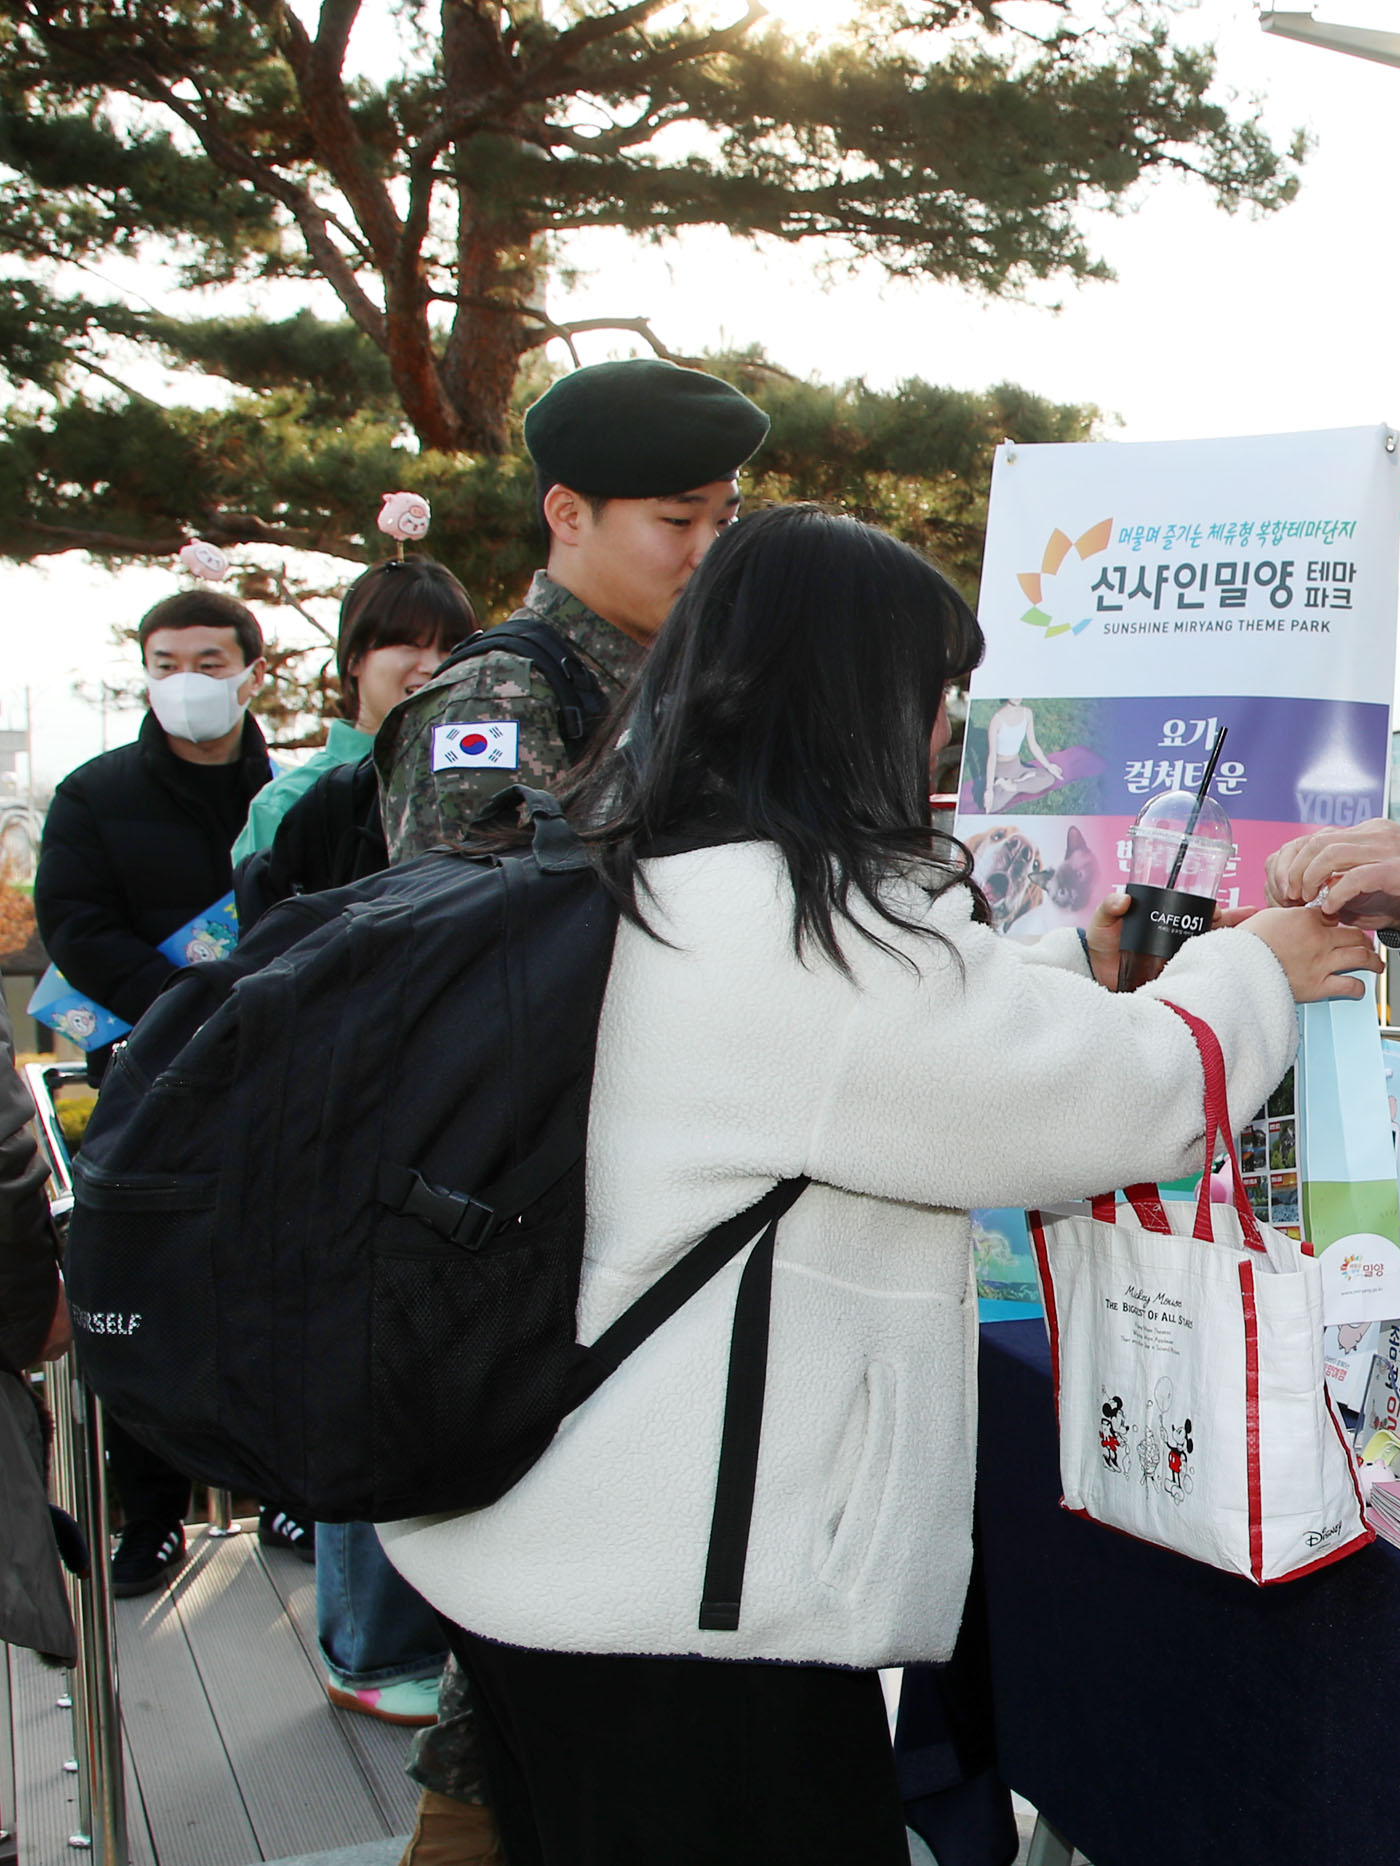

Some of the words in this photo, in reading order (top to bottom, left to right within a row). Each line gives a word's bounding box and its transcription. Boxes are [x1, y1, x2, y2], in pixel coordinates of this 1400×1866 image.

[1118, 525, 1162, 552] 머물며
[1162, 523, 1204, 551] 즐기는
[1207, 520, 1255, 548] 체류형
[1256, 519, 1358, 548] 복합테마단지
[1090, 559, 1295, 612] 선샤인밀양
[1306, 560, 1358, 584] 테마
[1303, 586, 1354, 610] 파크
[1103, 621, 1169, 635] SUNSHINE
[1173, 619, 1233, 634] MIRYANG
[1238, 618, 1286, 632] THEME
[1290, 619, 1331, 633] PARK
[1157, 717, 1219, 751] 요가
[1123, 759, 1248, 796] 컬쳐타운
[1295, 791, 1373, 827] YOGA
[1150, 910, 1181, 927] CAFE
[1181, 914, 1205, 932] 051
[1362, 1263, 1384, 1278] 밀양
[1124, 1285, 1151, 1309] Mickey
[1152, 1292, 1183, 1309] Mouse
[1105, 1298, 1119, 1311] THE
[1147, 1309, 1159, 1321] OF
[1161, 1311, 1177, 1323] ALL
